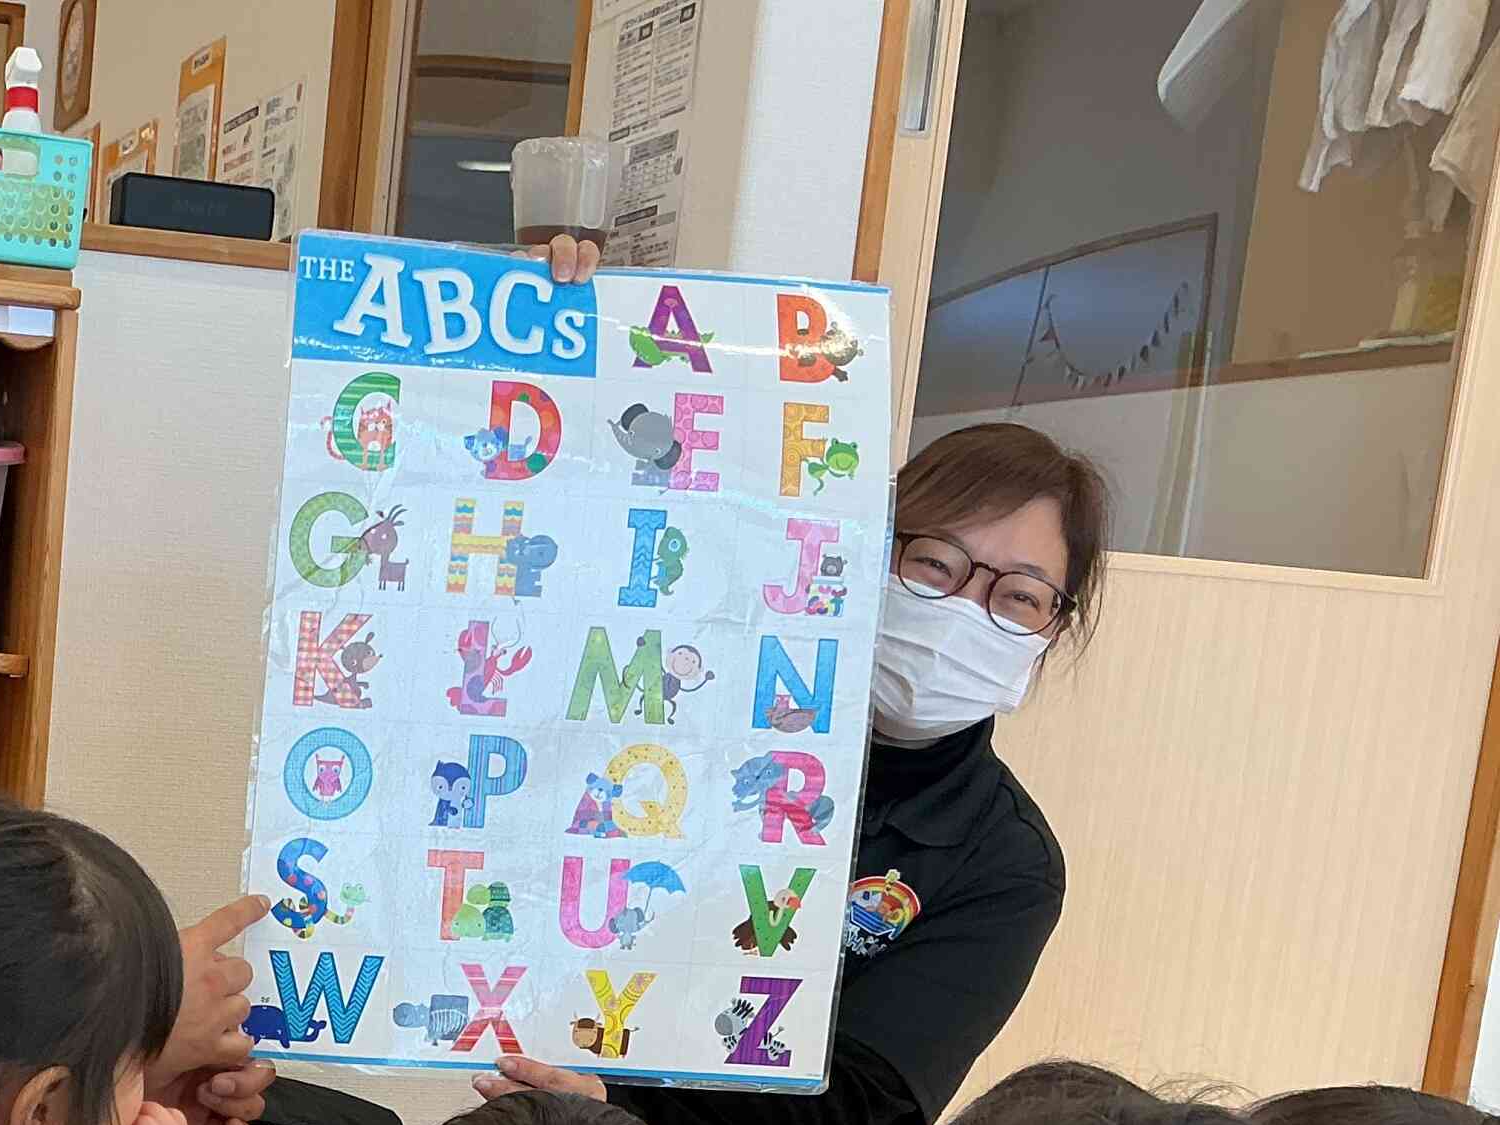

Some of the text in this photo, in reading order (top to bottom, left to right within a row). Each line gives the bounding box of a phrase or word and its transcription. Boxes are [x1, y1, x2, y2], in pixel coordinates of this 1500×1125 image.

[301, 253, 587, 360] THE ABCs
[631, 285, 832, 383] A B
[331, 372, 830, 497] C D E F
[289, 491, 840, 614] G H I J
[293, 611, 839, 734] K L M N
[283, 727, 827, 846] O P Q R
[271, 837, 817, 958] S T U V
[269, 950, 803, 1068] W X Y Z
